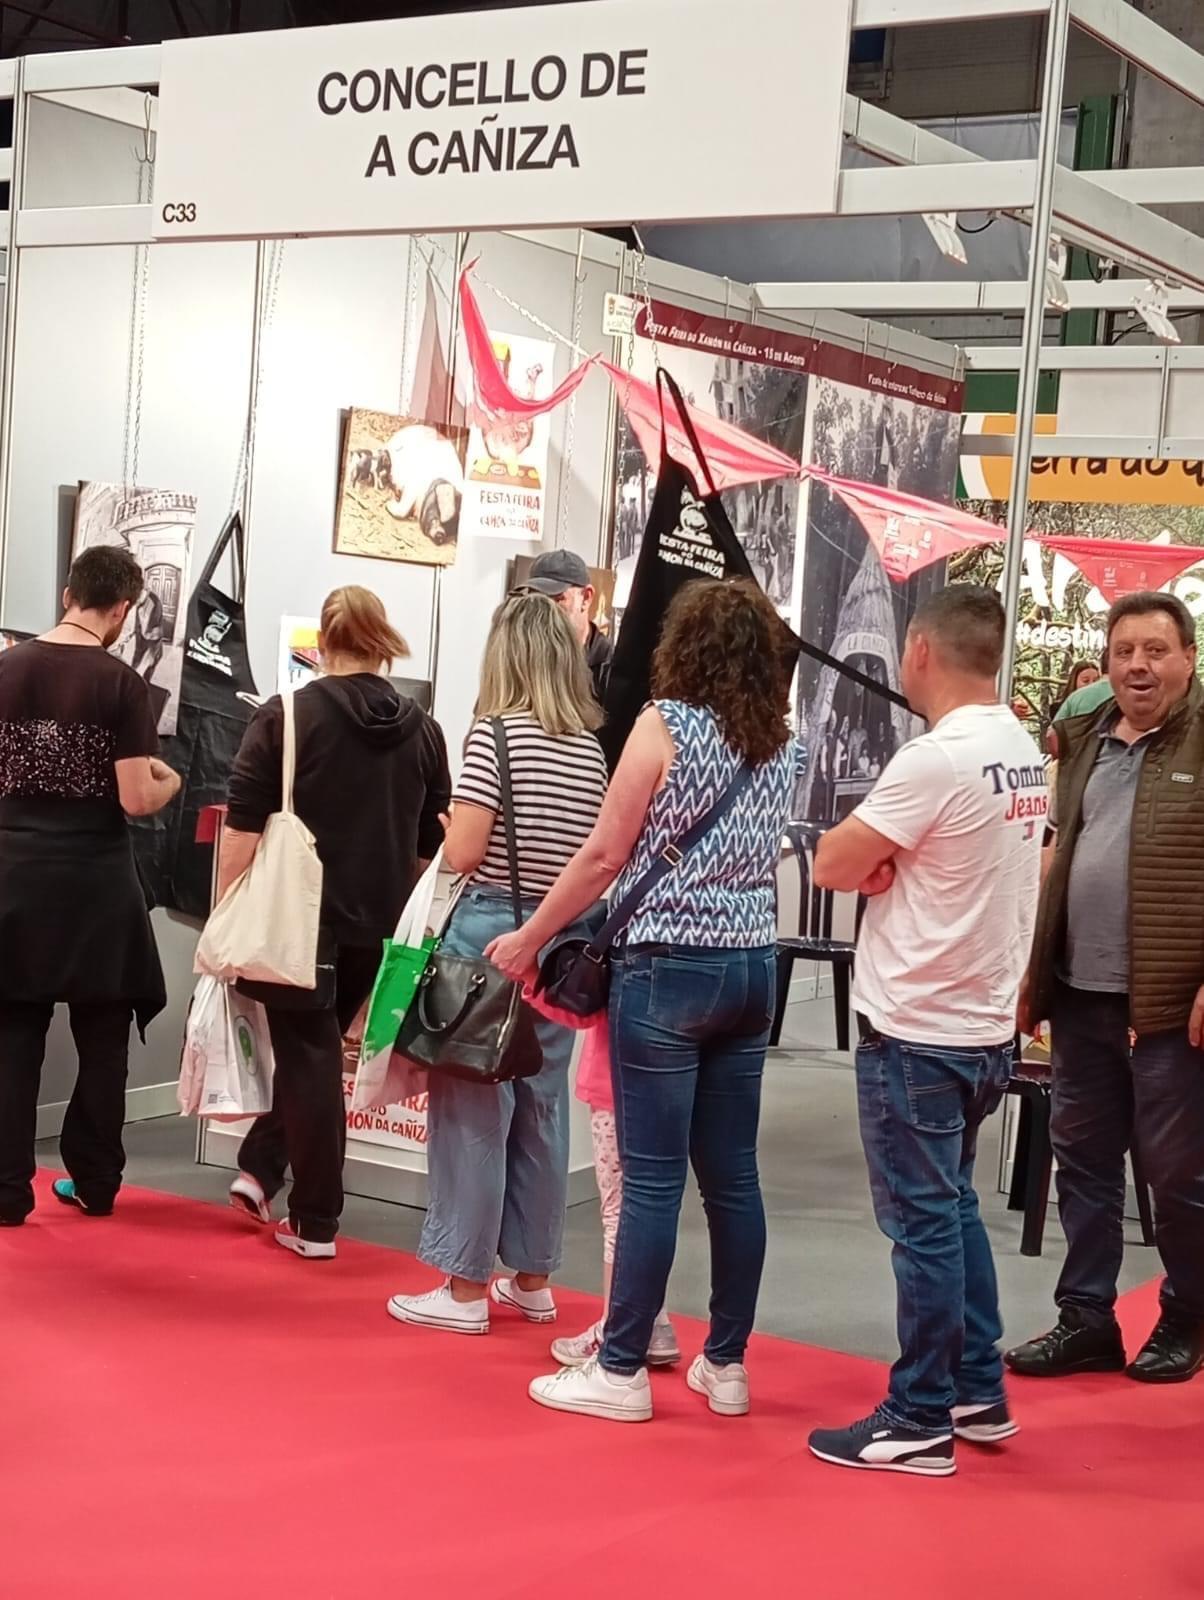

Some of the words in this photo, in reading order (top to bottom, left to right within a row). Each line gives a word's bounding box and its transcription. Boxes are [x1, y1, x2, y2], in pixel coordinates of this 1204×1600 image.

[318, 55, 567, 115] CONCELLO
[580, 48, 648, 98] DE
[365, 134, 396, 178] A
[407, 113, 580, 176] CAÑIZA
[162, 203, 197, 223] C33
[764, 346, 774, 360] 15
[1016, 619, 1107, 649] #destin
[1005, 792, 1047, 820] Jeans
[375, 1118, 389, 1133] DA
